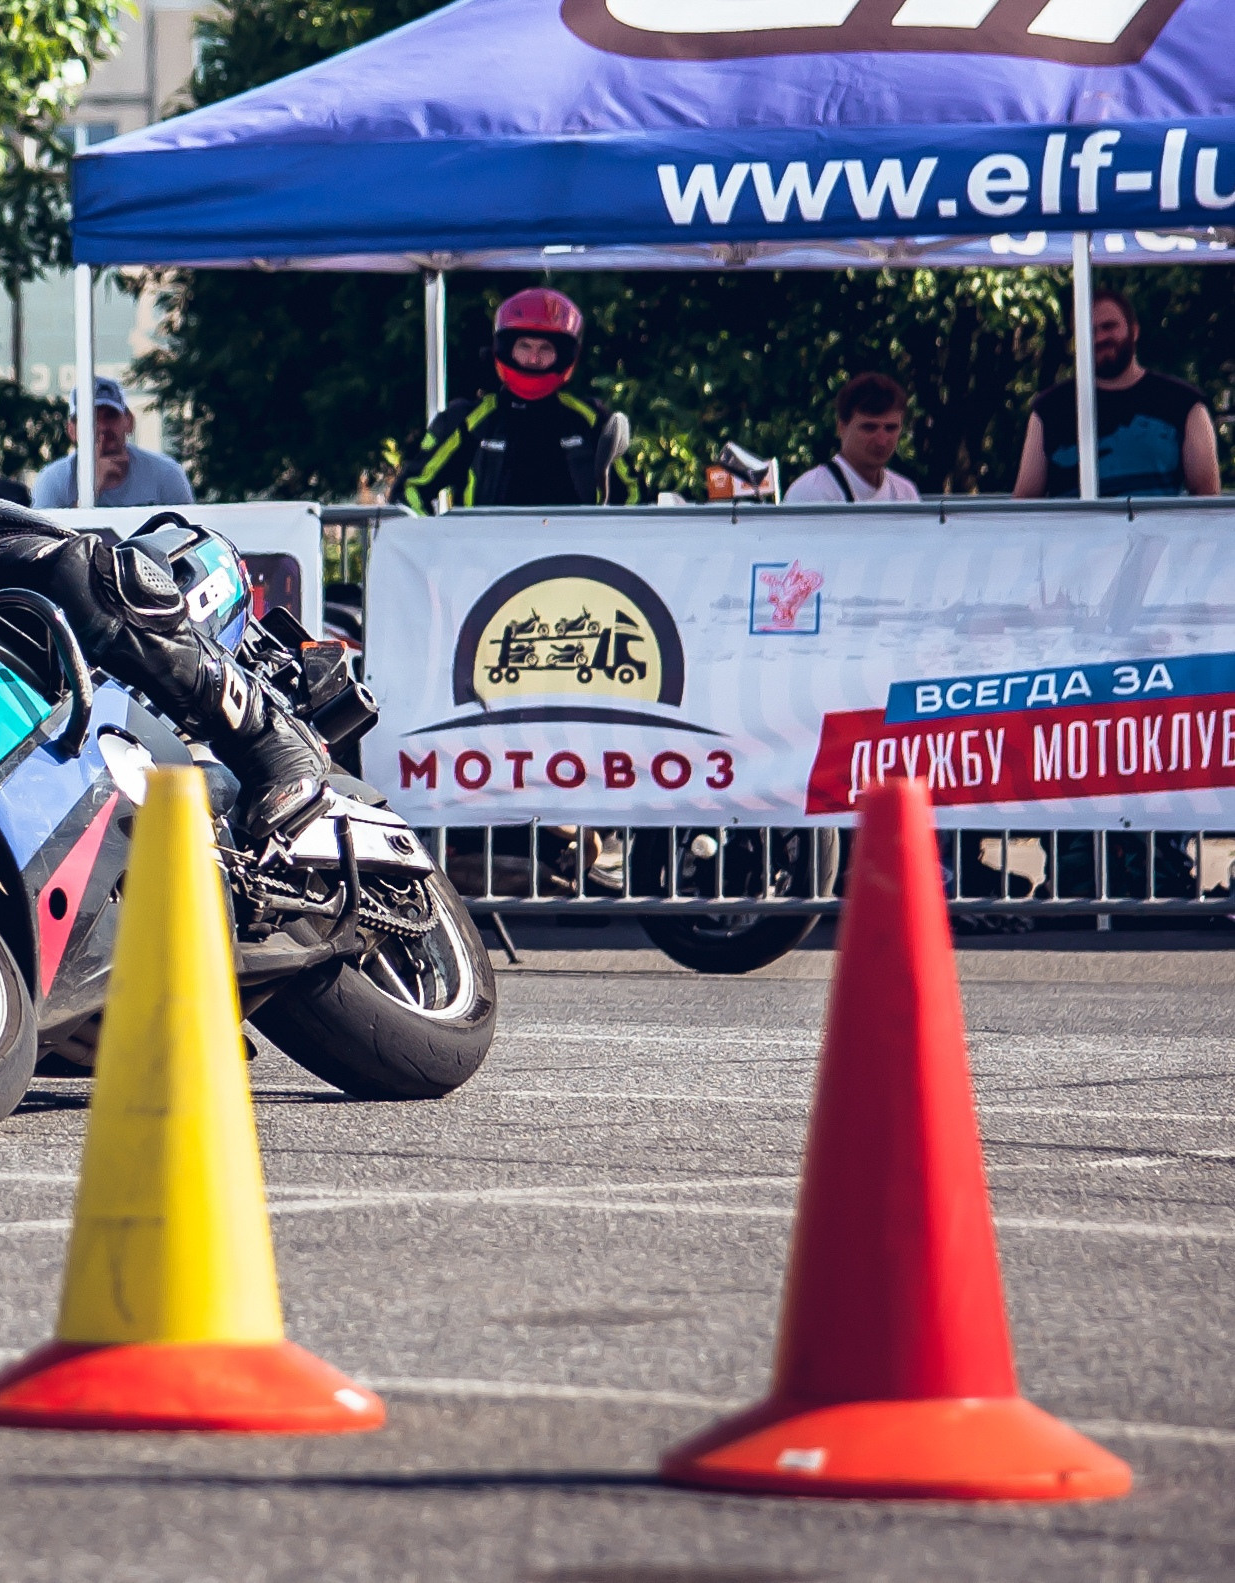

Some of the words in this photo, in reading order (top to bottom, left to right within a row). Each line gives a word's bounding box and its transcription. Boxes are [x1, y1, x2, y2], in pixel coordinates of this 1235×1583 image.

[657, 127, 1235, 226] www.elf-lu
[915, 669, 1093, 714] ВСЕГДА
[1111, 663, 1174, 695] ЗА
[398, 749, 735, 791] МОТОВОЗ
[848, 727, 1006, 805] ДРУЖБУ
